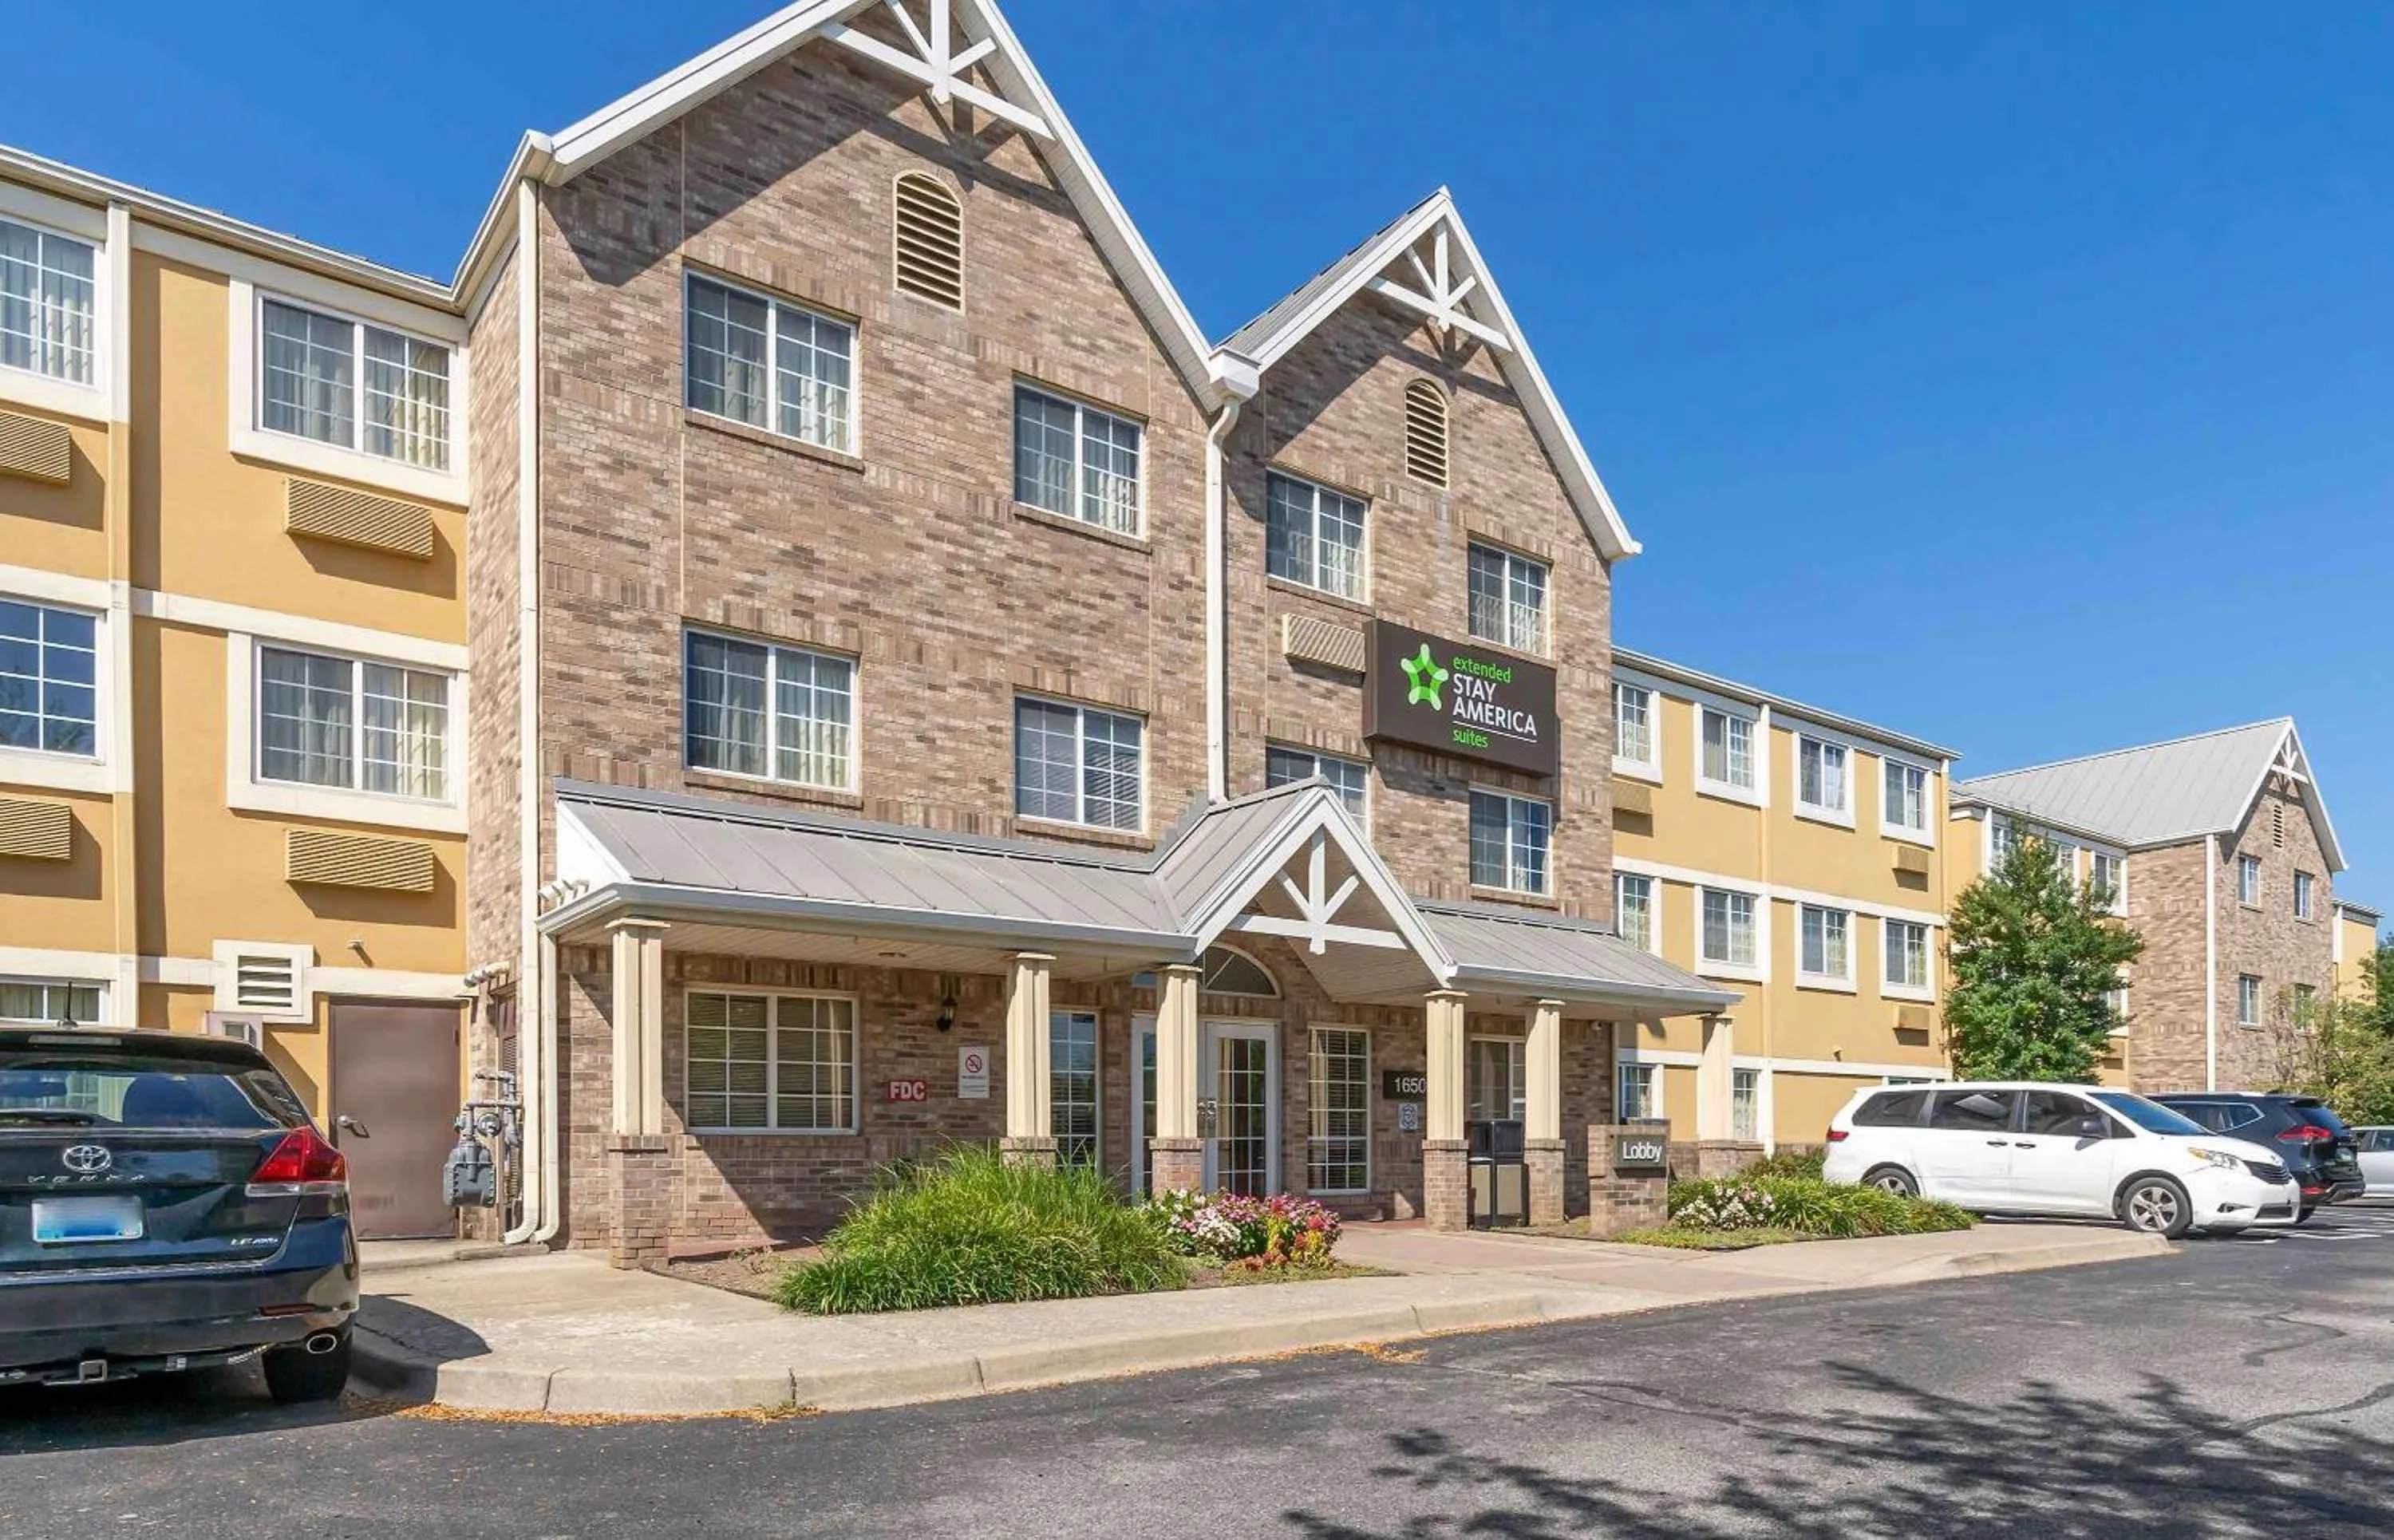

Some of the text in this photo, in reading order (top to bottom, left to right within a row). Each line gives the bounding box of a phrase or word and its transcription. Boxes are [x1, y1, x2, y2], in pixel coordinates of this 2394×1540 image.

[1452, 657, 1511, 683] extended
[1452, 673, 1497, 702] STAY
[1452, 697, 1538, 736] AMERICA
[1452, 729, 1488, 748] suites
[890, 1080, 925, 1100] FDC
[1394, 1076, 1426, 1094] 1650
[1622, 1141, 1662, 1163] Lobby
